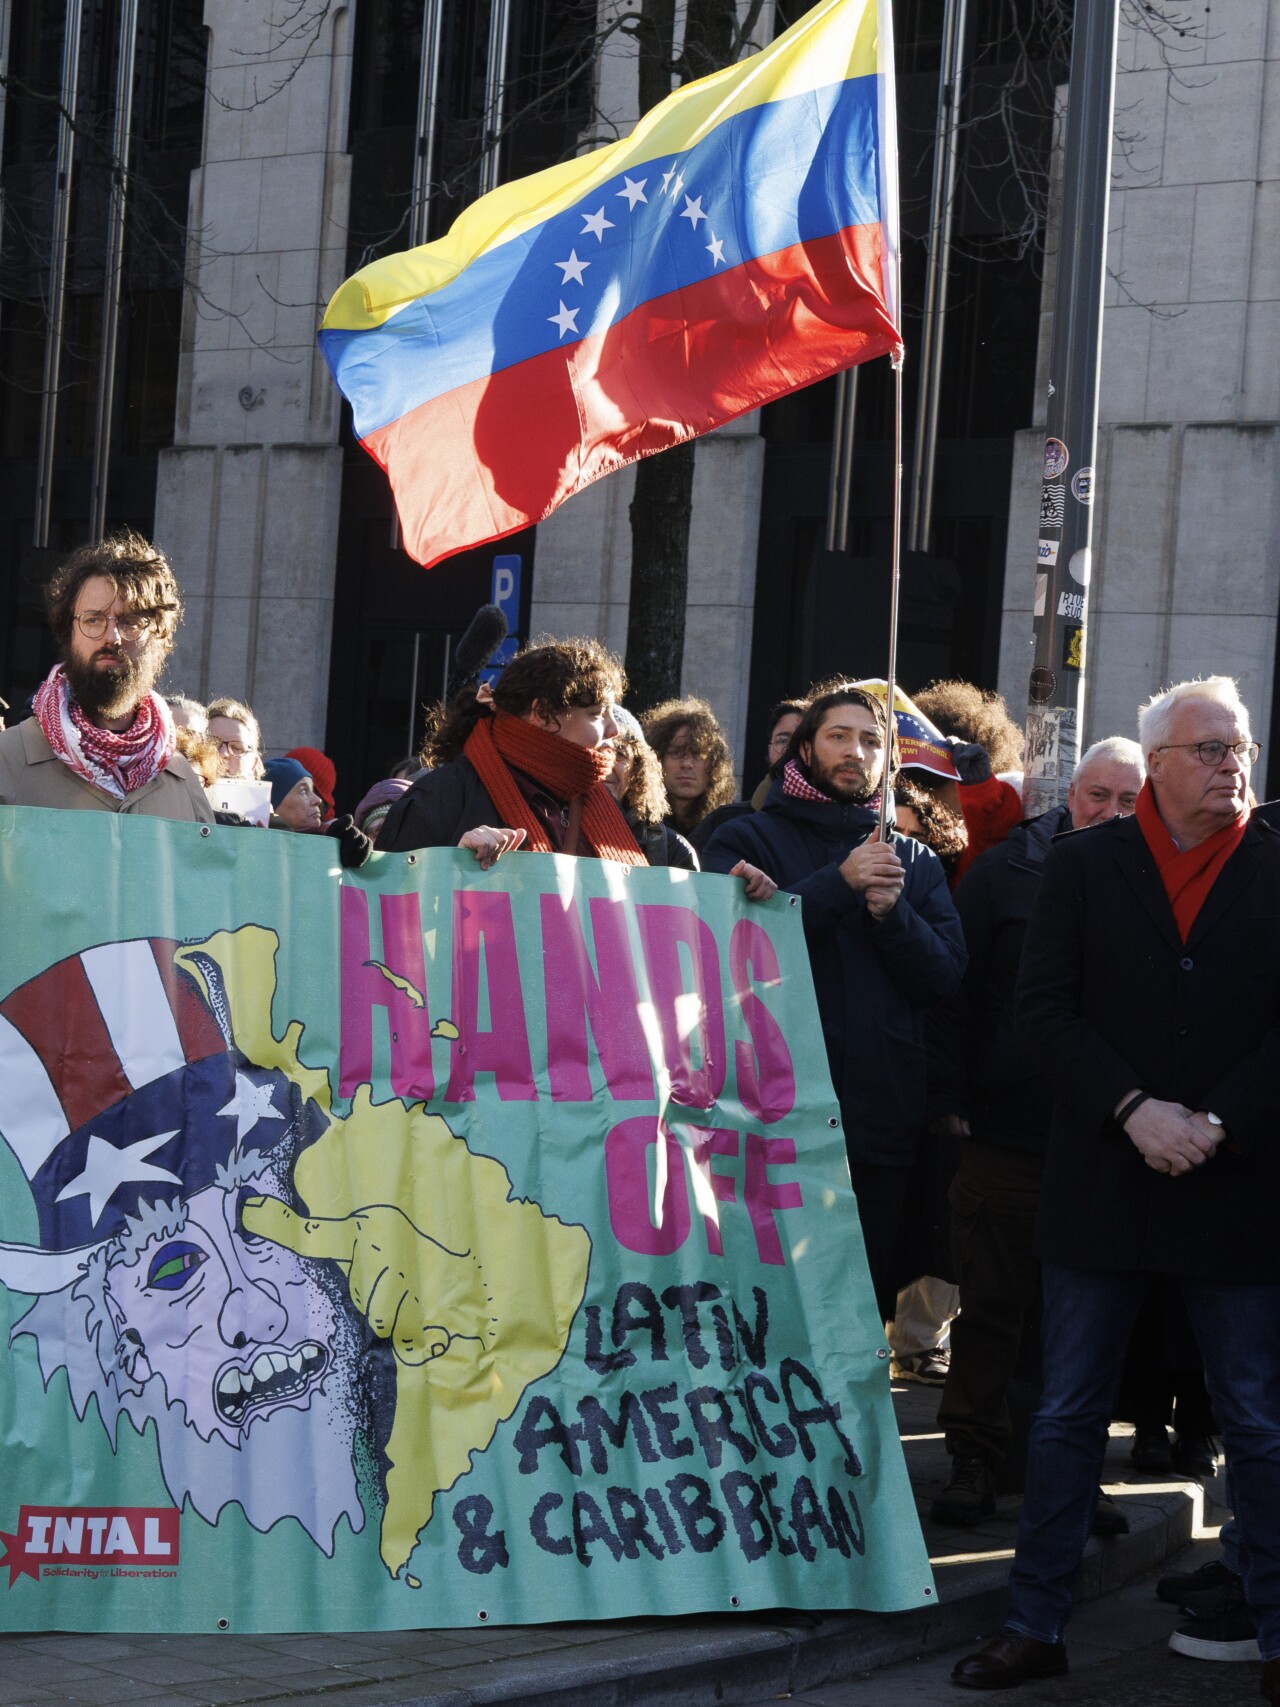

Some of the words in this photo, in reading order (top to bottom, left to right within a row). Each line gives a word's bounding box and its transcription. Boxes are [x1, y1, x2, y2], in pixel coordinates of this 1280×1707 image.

[494, 568, 514, 607] P
[1064, 605, 1081, 618] SUD
[338, 885, 798, 1125] HANDS
[604, 1115, 804, 1266] OFF
[584, 1280, 769, 1375] LATIN
[512, 1357, 862, 1477] AMERICA
[24, 1516, 171, 1555] INTAL
[452, 1495, 509, 1574] &
[528, 1470, 866, 1568] CARIBBEAN
[43, 1566, 98, 1579] Solidarity
[110, 1568, 177, 1578] Liberation
